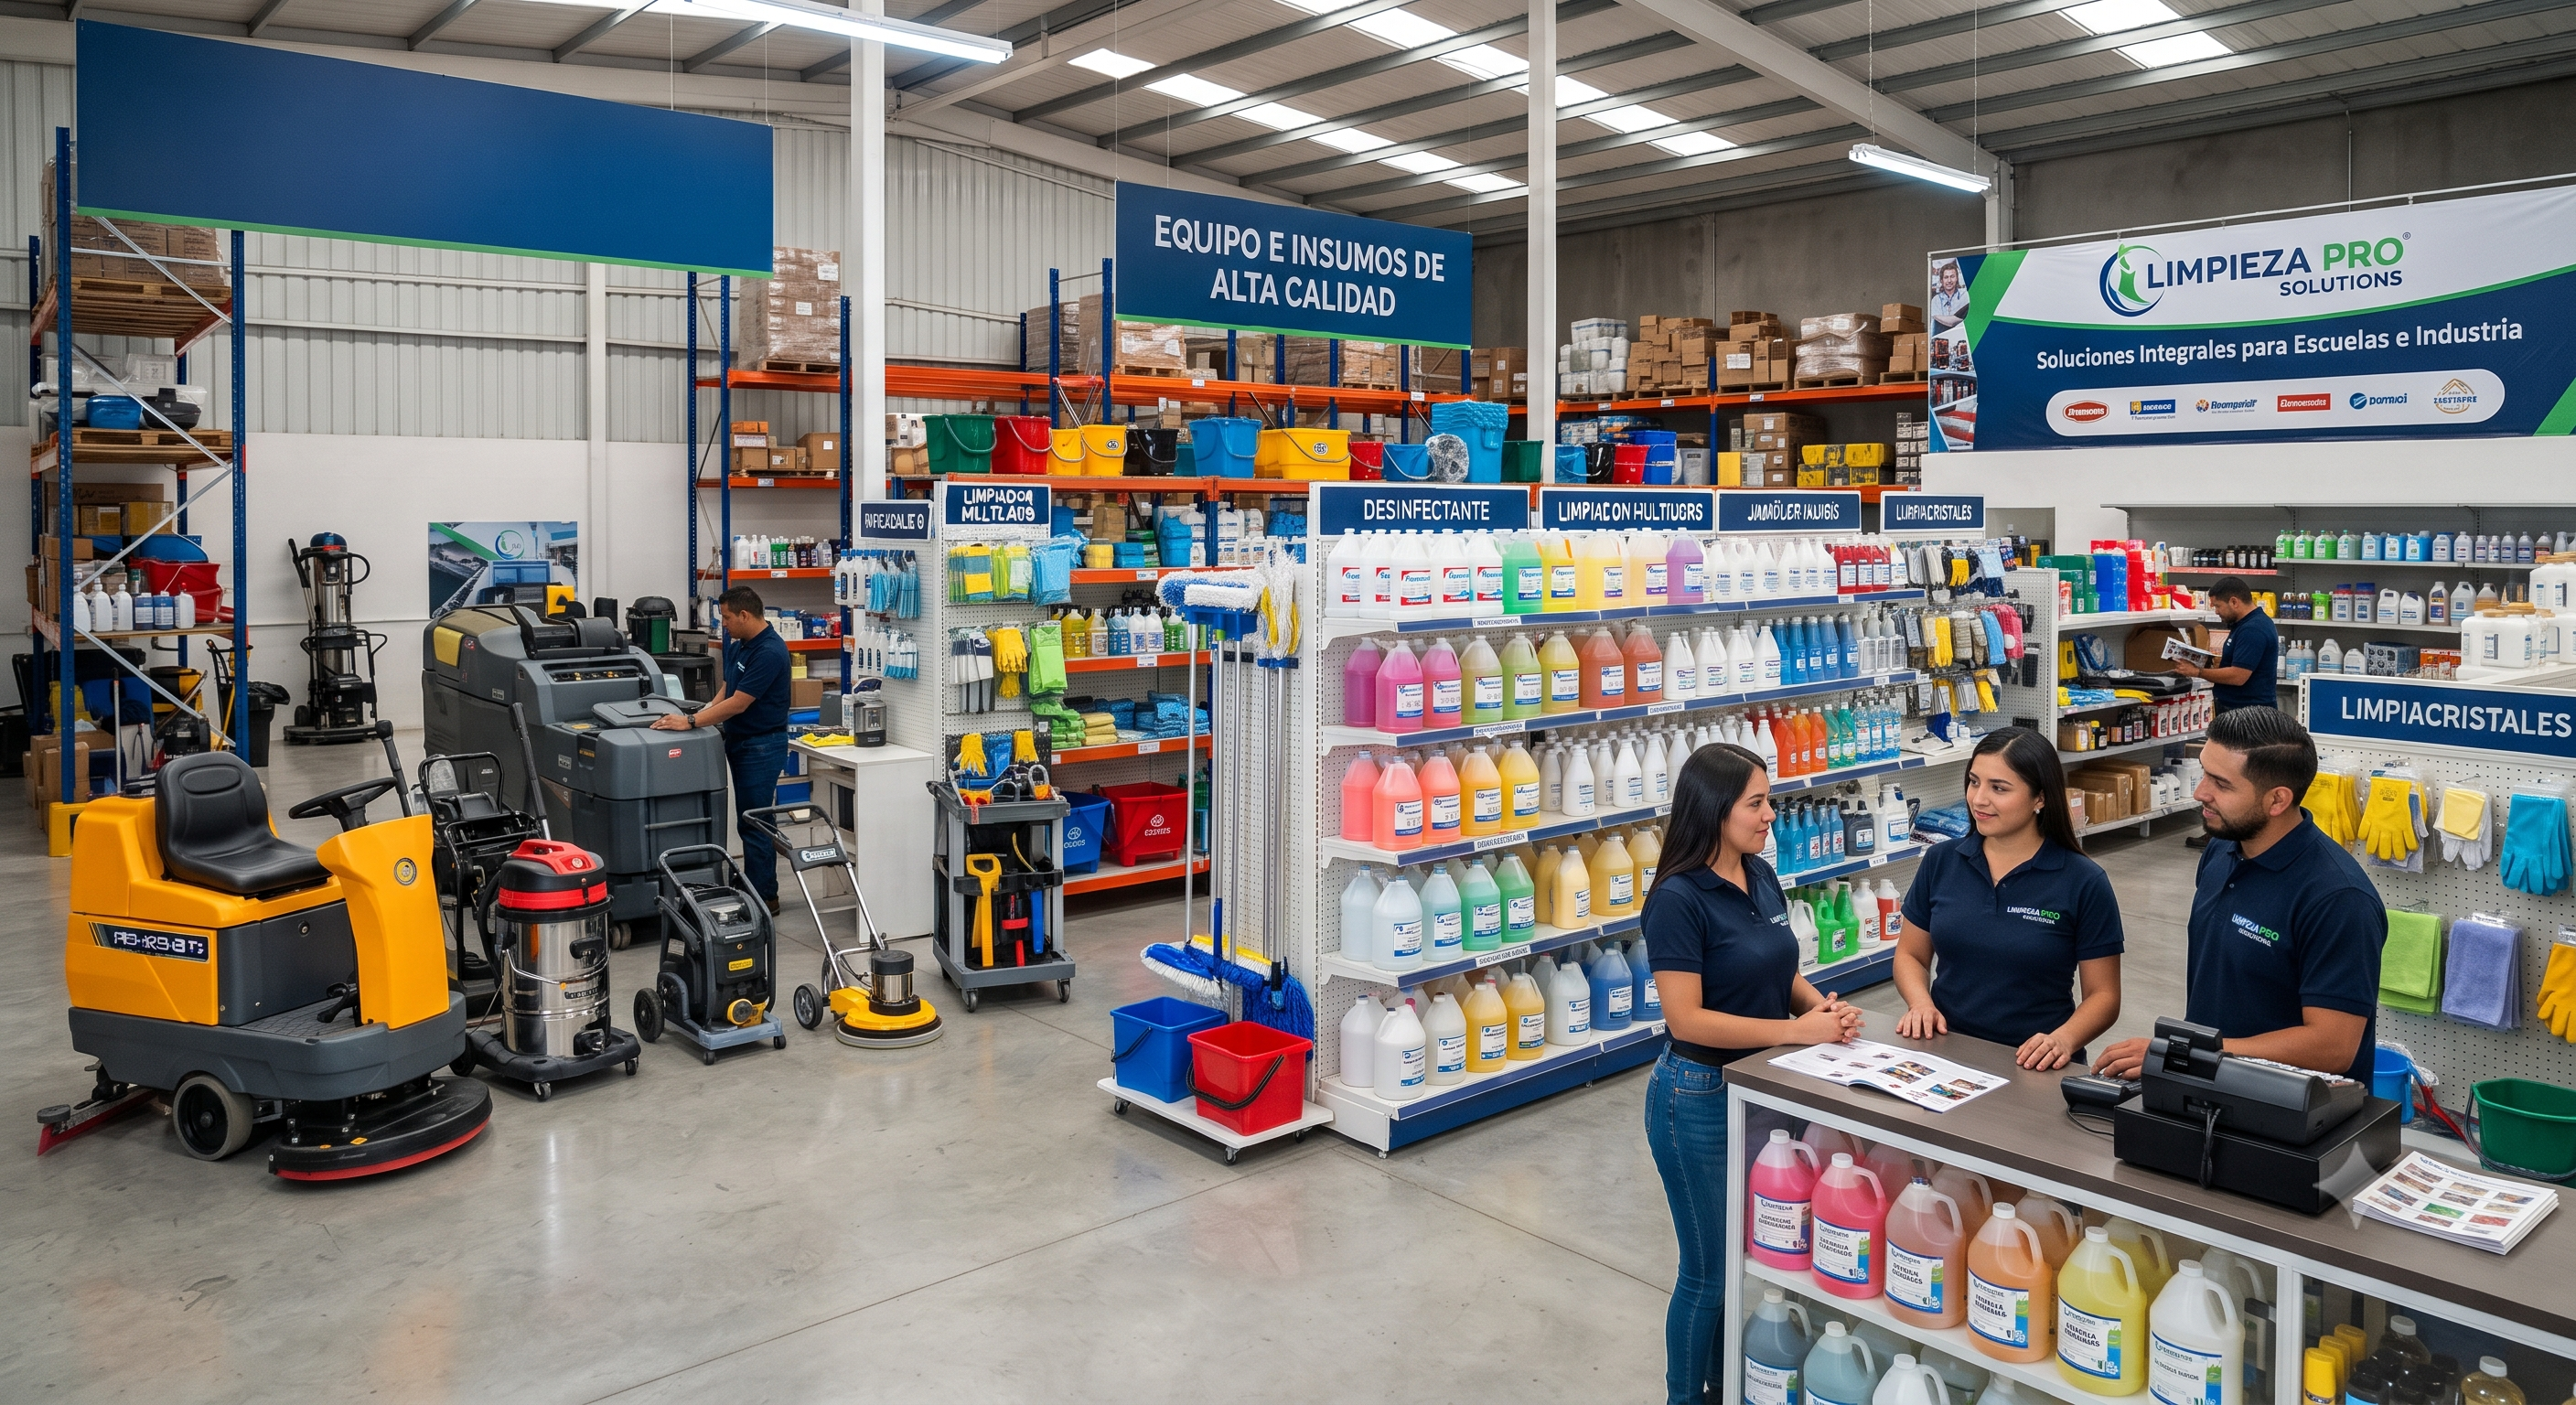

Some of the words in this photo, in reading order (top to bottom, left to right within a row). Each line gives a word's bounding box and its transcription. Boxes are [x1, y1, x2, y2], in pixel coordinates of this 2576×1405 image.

[1154, 214, 1261, 261] EQUIPO
[1269, 231, 1285, 263] E
[1292, 234, 1408, 278] INSUMOS
[1414, 251, 1445, 282] DE
[2146, 247, 2312, 289] LIMPIEZA
[2322, 237, 2405, 272] PRO
[1210, 268, 1280, 306] ALTA
[1284, 276, 1396, 316] CALIDAD
[2279, 270, 2403, 297] SOLUTIONS
[2036, 344, 2135, 370] Soluciones
[2140, 338, 2237, 367] Integrales
[2241, 337, 2289, 362] para
[2294, 328, 2389, 355] Escuelas
[2396, 330, 2410, 349] e
[2416, 316, 2523, 343] Industria
[1364, 499, 1490, 521] DESINFECTANTE
[2341, 696, 2571, 738] LIMPIACRISTALES
